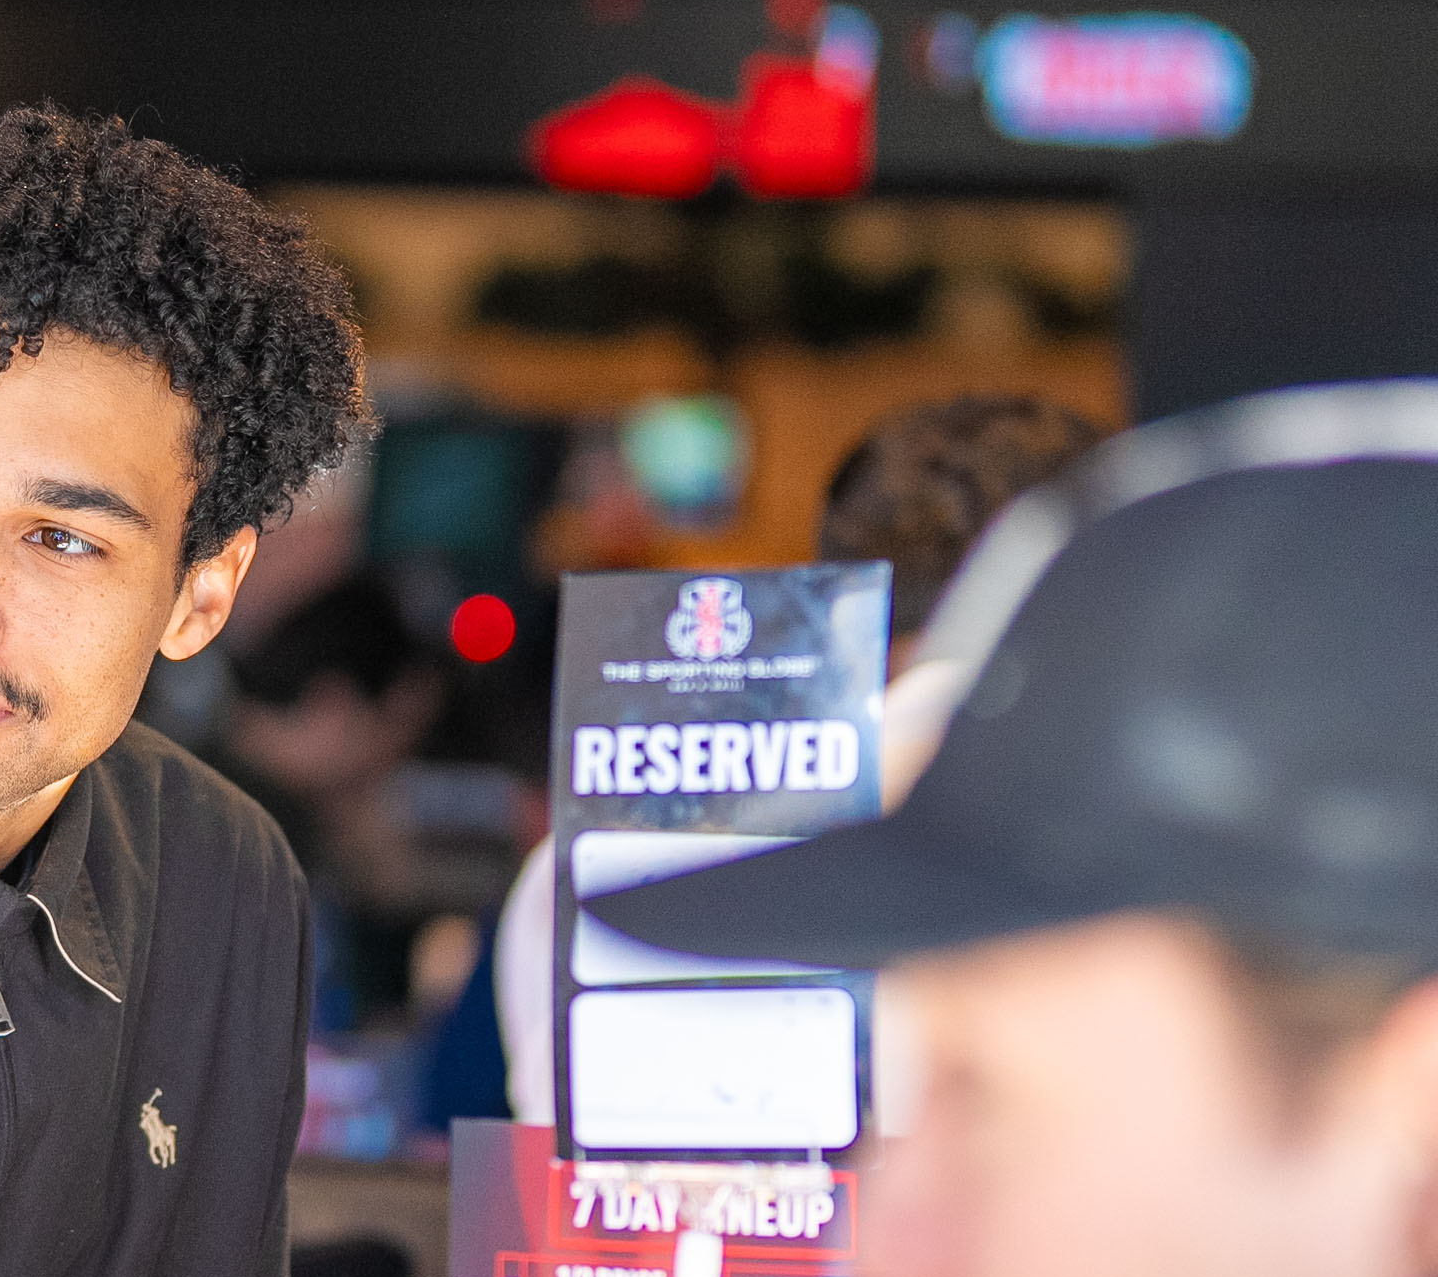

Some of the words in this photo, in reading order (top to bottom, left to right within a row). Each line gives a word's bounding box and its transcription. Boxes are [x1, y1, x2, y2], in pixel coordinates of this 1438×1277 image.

[572, 720, 859, 795] RESERVED
[570, 1180, 597, 1228] 7
[601, 1182, 681, 1232] DAY
